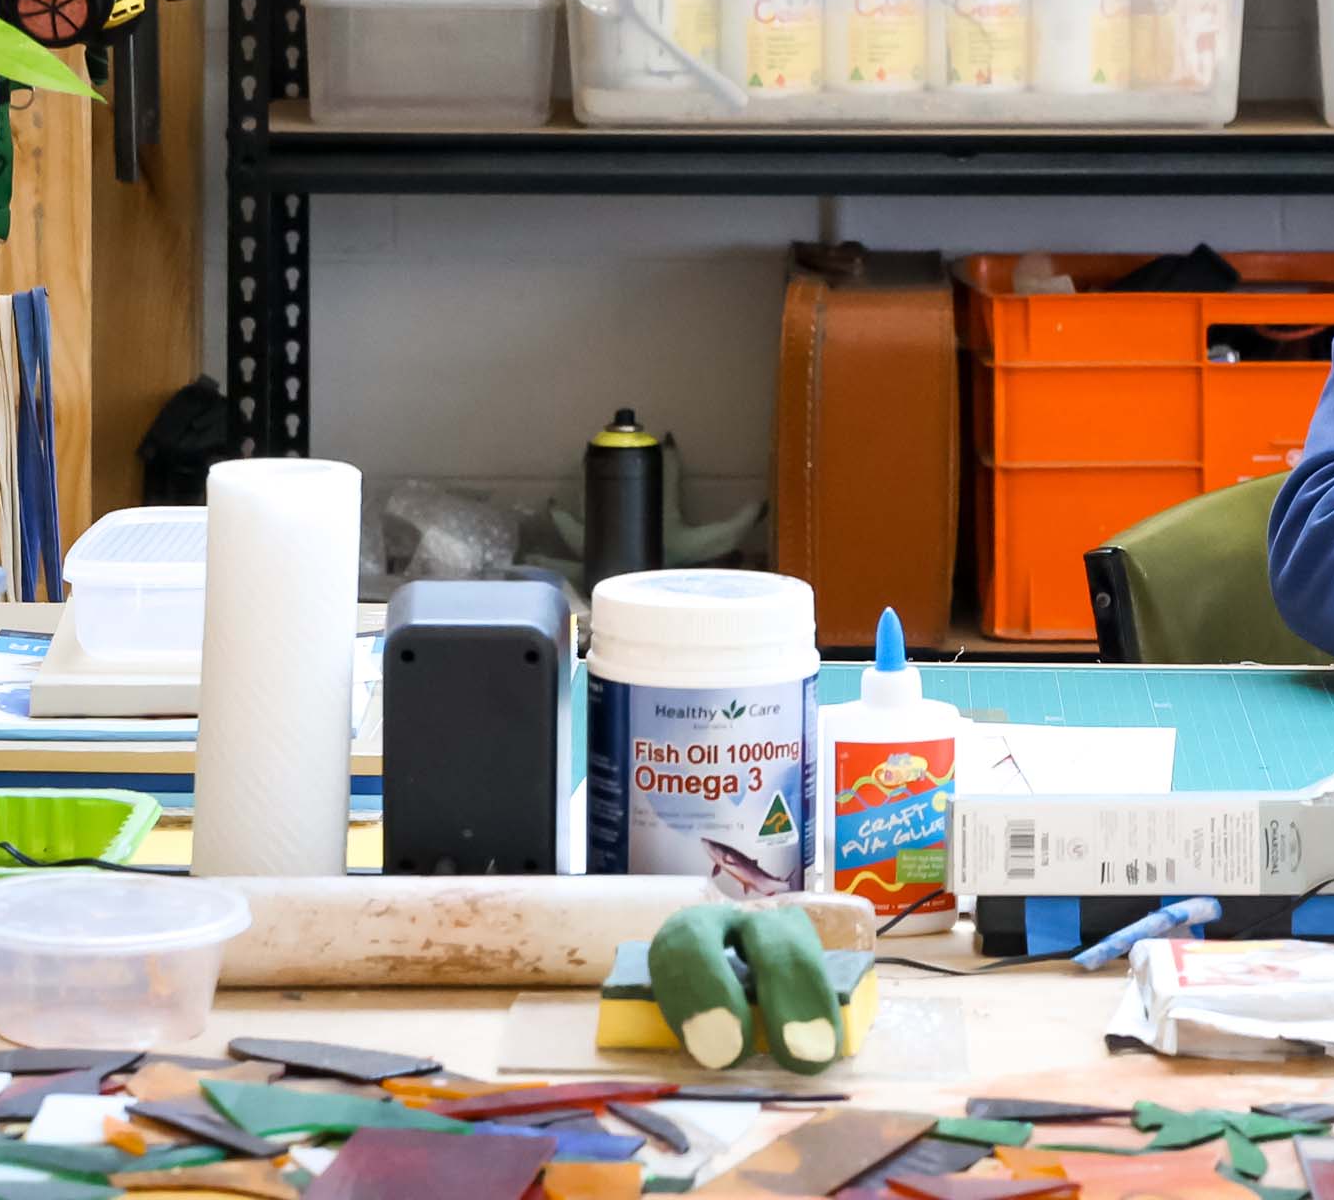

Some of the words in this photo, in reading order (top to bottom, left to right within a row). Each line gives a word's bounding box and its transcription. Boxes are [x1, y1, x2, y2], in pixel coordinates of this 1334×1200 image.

[655, 704, 717, 721] Healthy
[748, 703, 782, 718] Care
[635, 741, 680, 764] Fish
[687, 745, 718, 765] Oil
[726, 740, 801, 763] 1000mg
[635, 765, 739, 801] Omega
[747, 766, 763, 792] 3
[841, 837, 887, 860] PVA
[893, 815, 946, 846] GLUE
[858, 802, 930, 839] CRAFT
[1268, 819, 1281, 877] CHARCOAL
